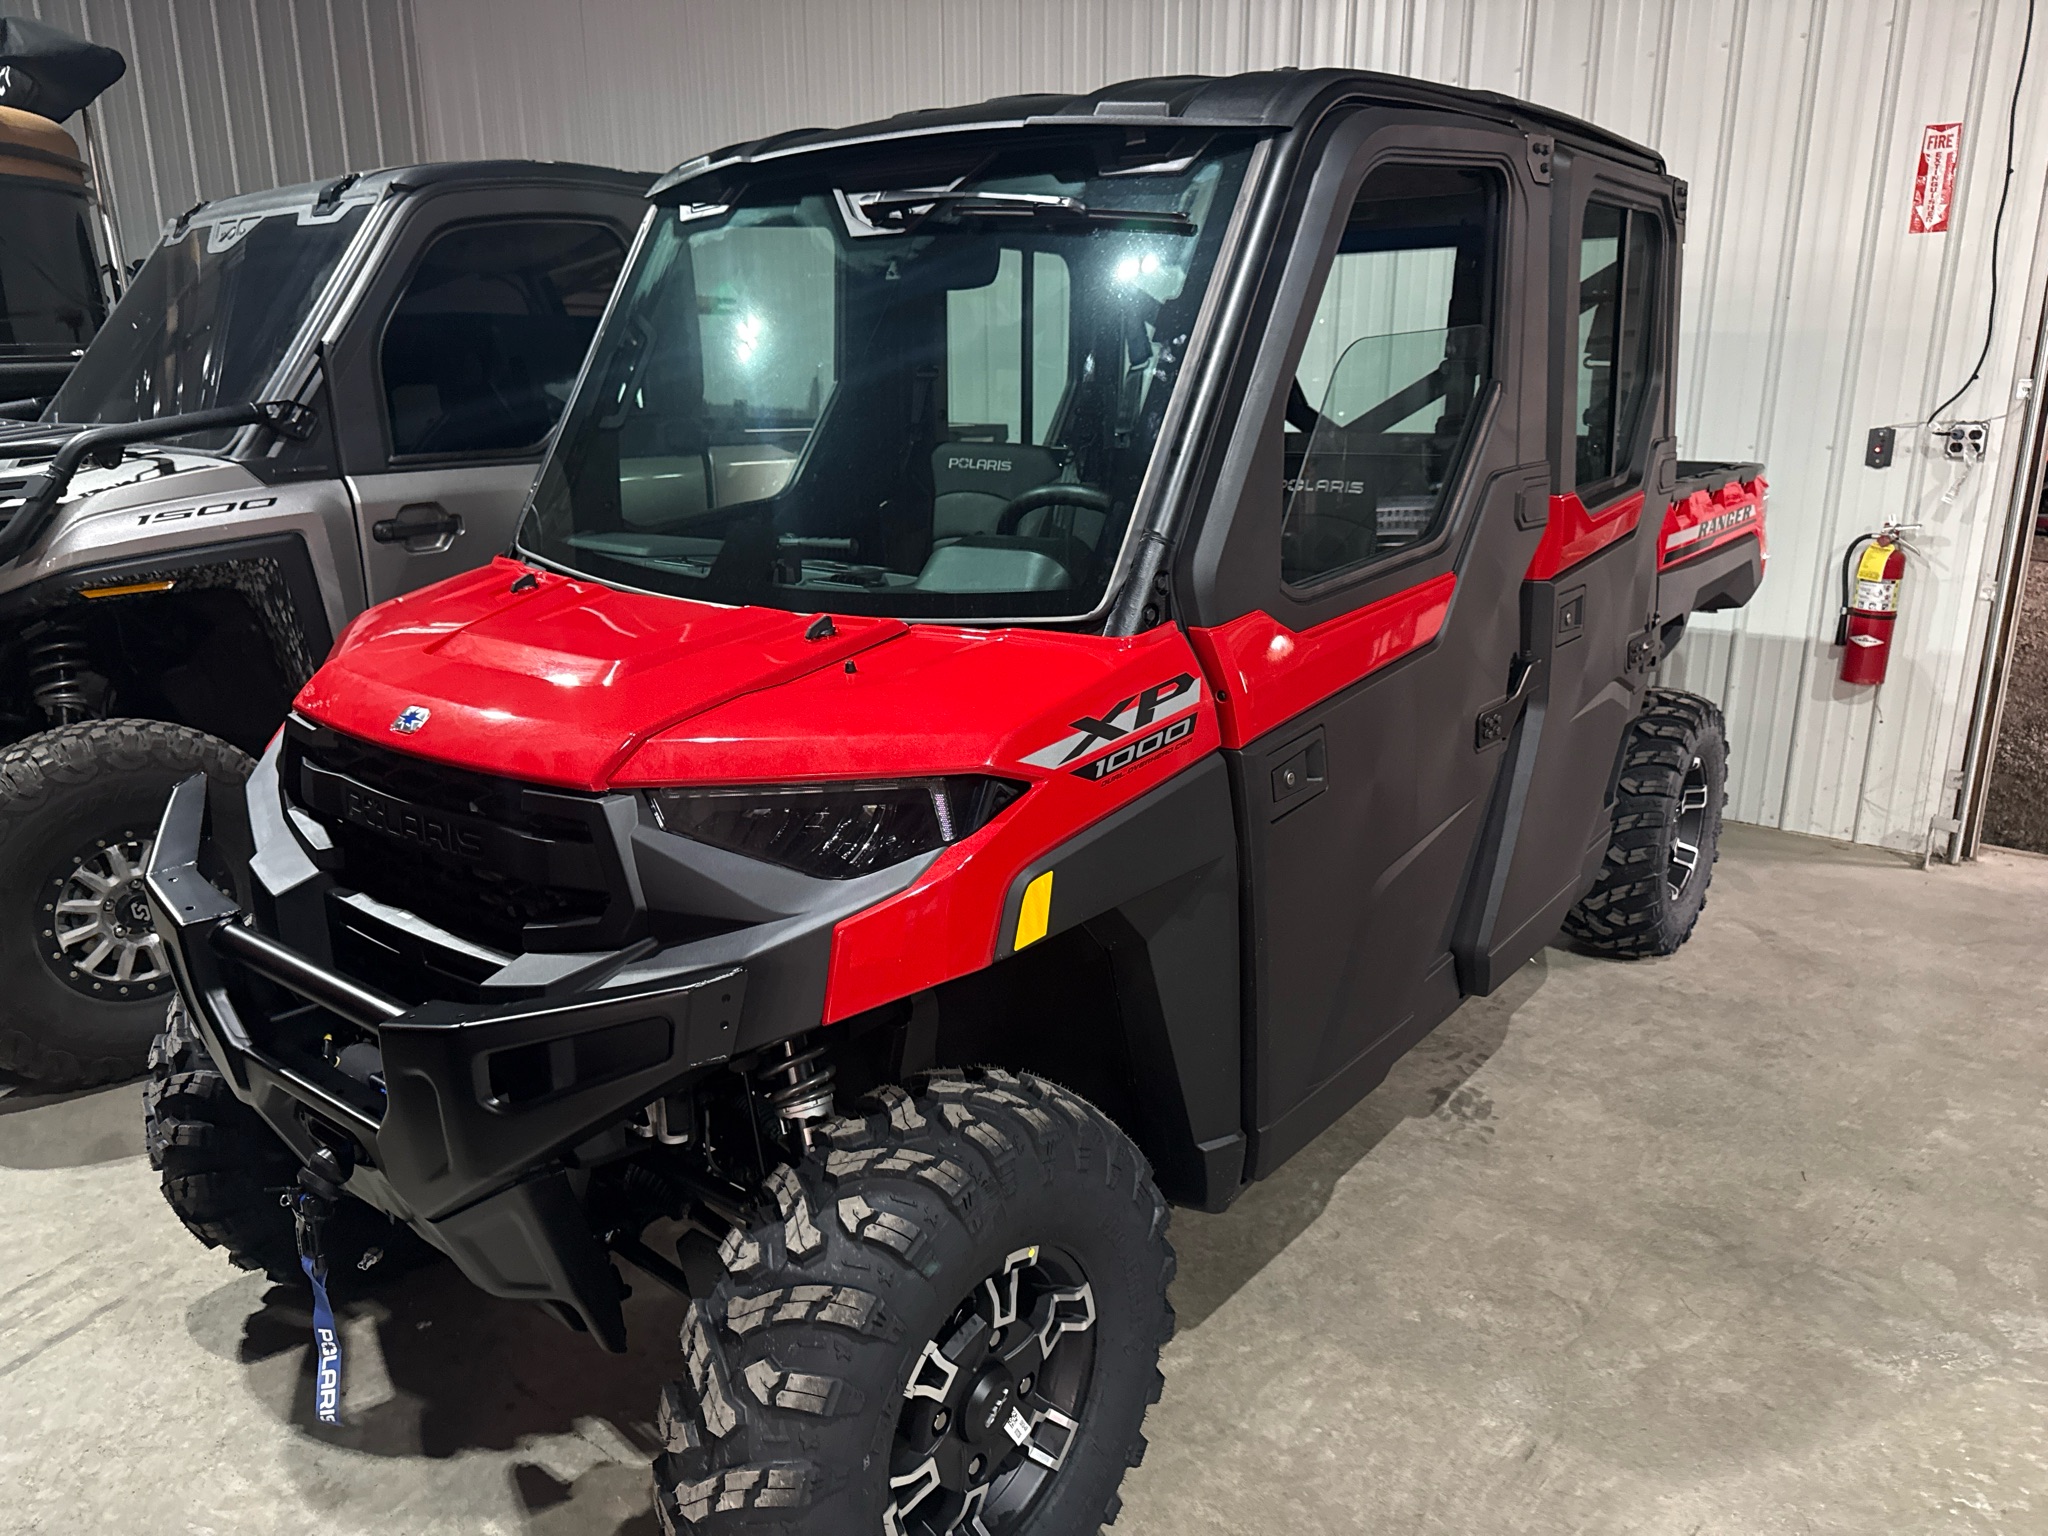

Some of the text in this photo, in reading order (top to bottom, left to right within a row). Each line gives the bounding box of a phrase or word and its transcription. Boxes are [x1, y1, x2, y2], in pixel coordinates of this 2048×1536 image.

[1927, 133, 1954, 149] FIRE
[1926, 151, 1942, 223] EXTINGUISHER
[948, 457, 1012, 472] POLARIS
[137, 497, 278, 526] 1500
[1698, 504, 1752, 538] RANGER
[1057, 672, 1196, 766] XP
[1095, 717, 1191, 779] 1000
[346, 790, 482, 861] POLARIS
